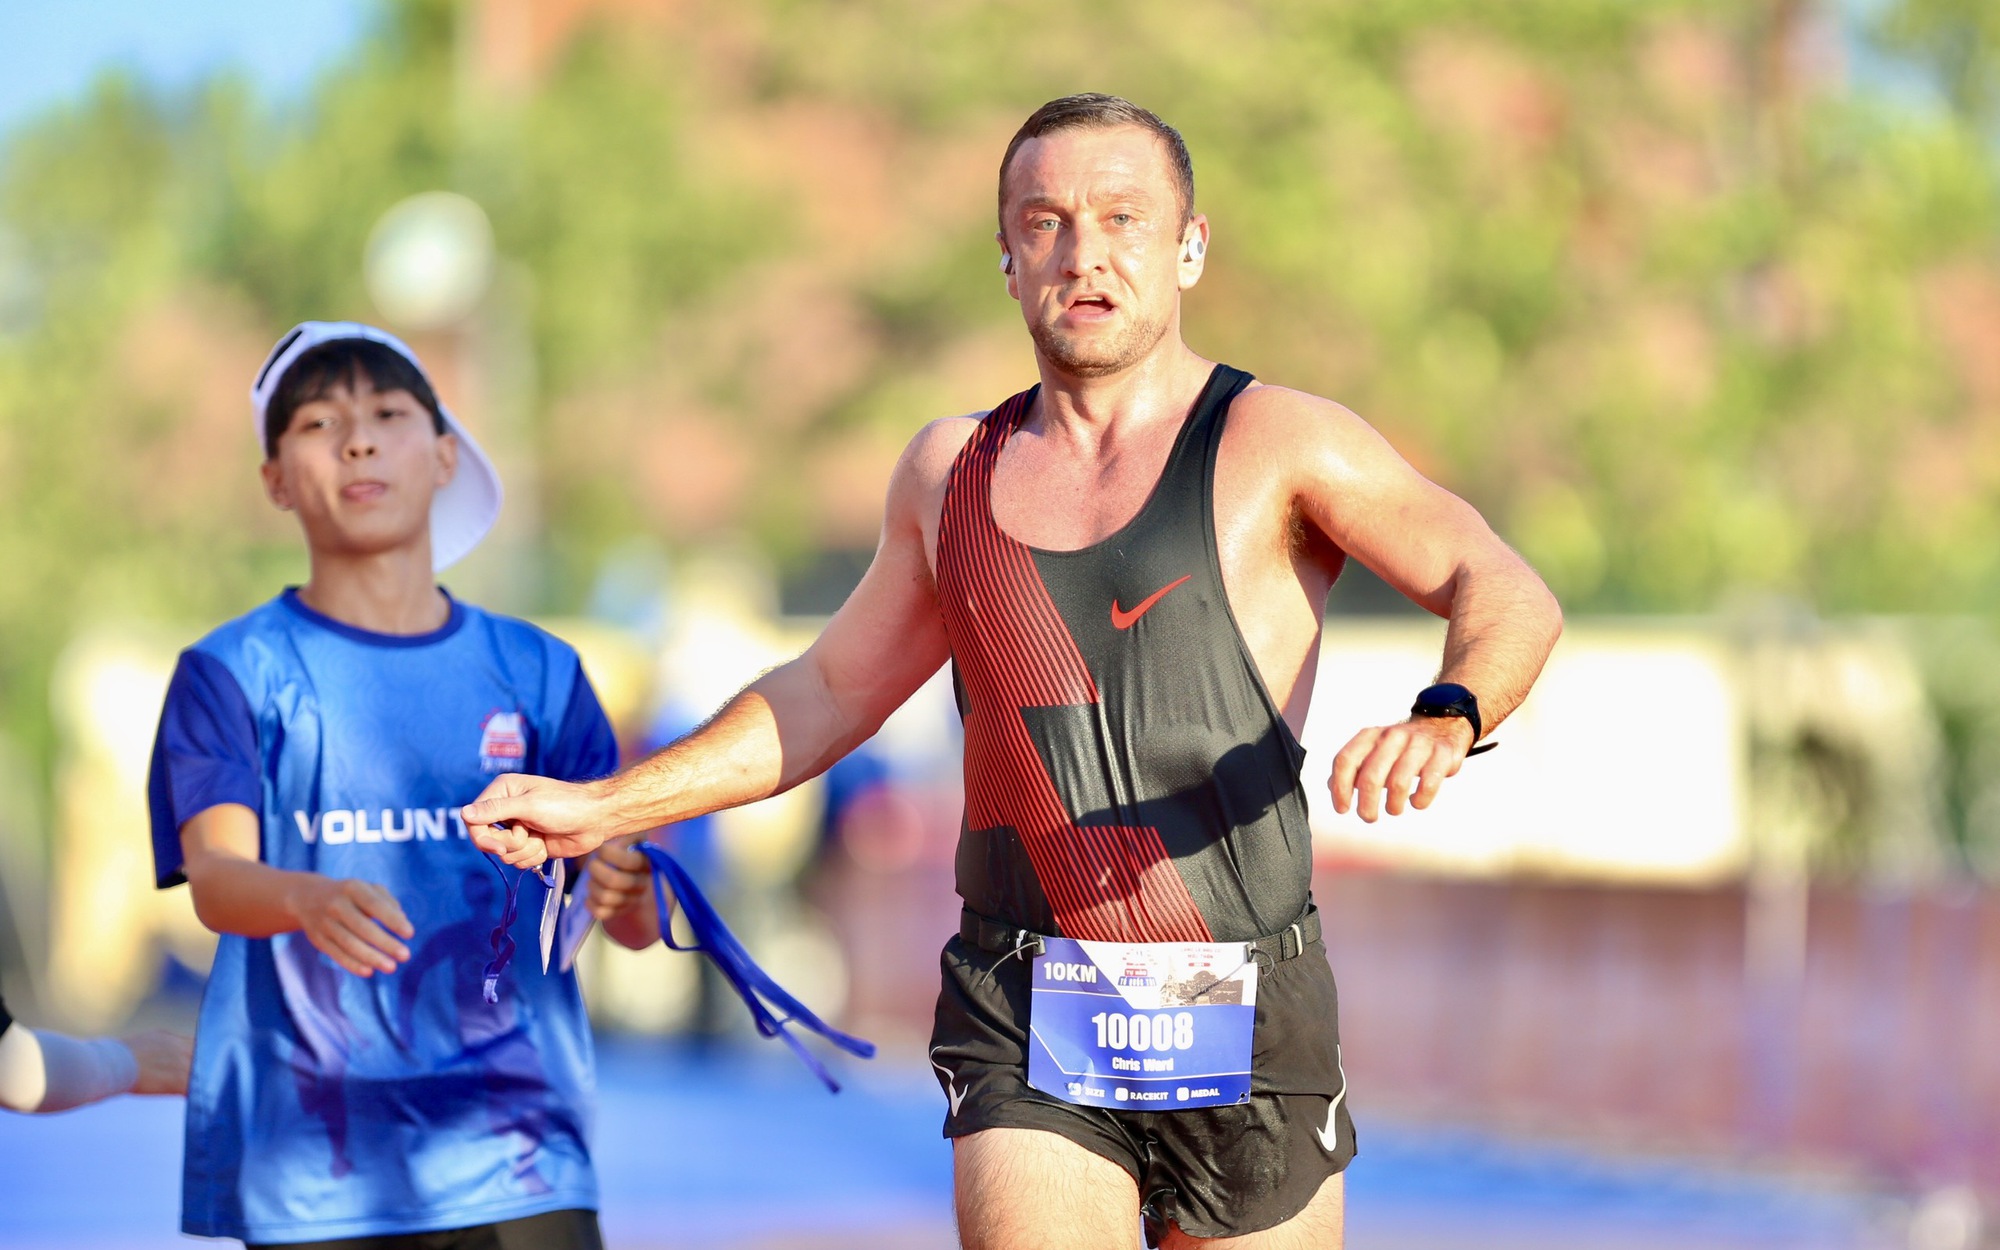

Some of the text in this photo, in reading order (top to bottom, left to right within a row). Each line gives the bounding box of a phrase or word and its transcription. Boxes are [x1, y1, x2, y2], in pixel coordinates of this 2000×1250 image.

[1043, 961, 1097, 984] 10KM
[1091, 1011, 1194, 1052] 10008
[1112, 1056, 1174, 1072] Chris Ward
[1084, 1087, 1220, 1101] SIZE RACEKIT MEDAL
